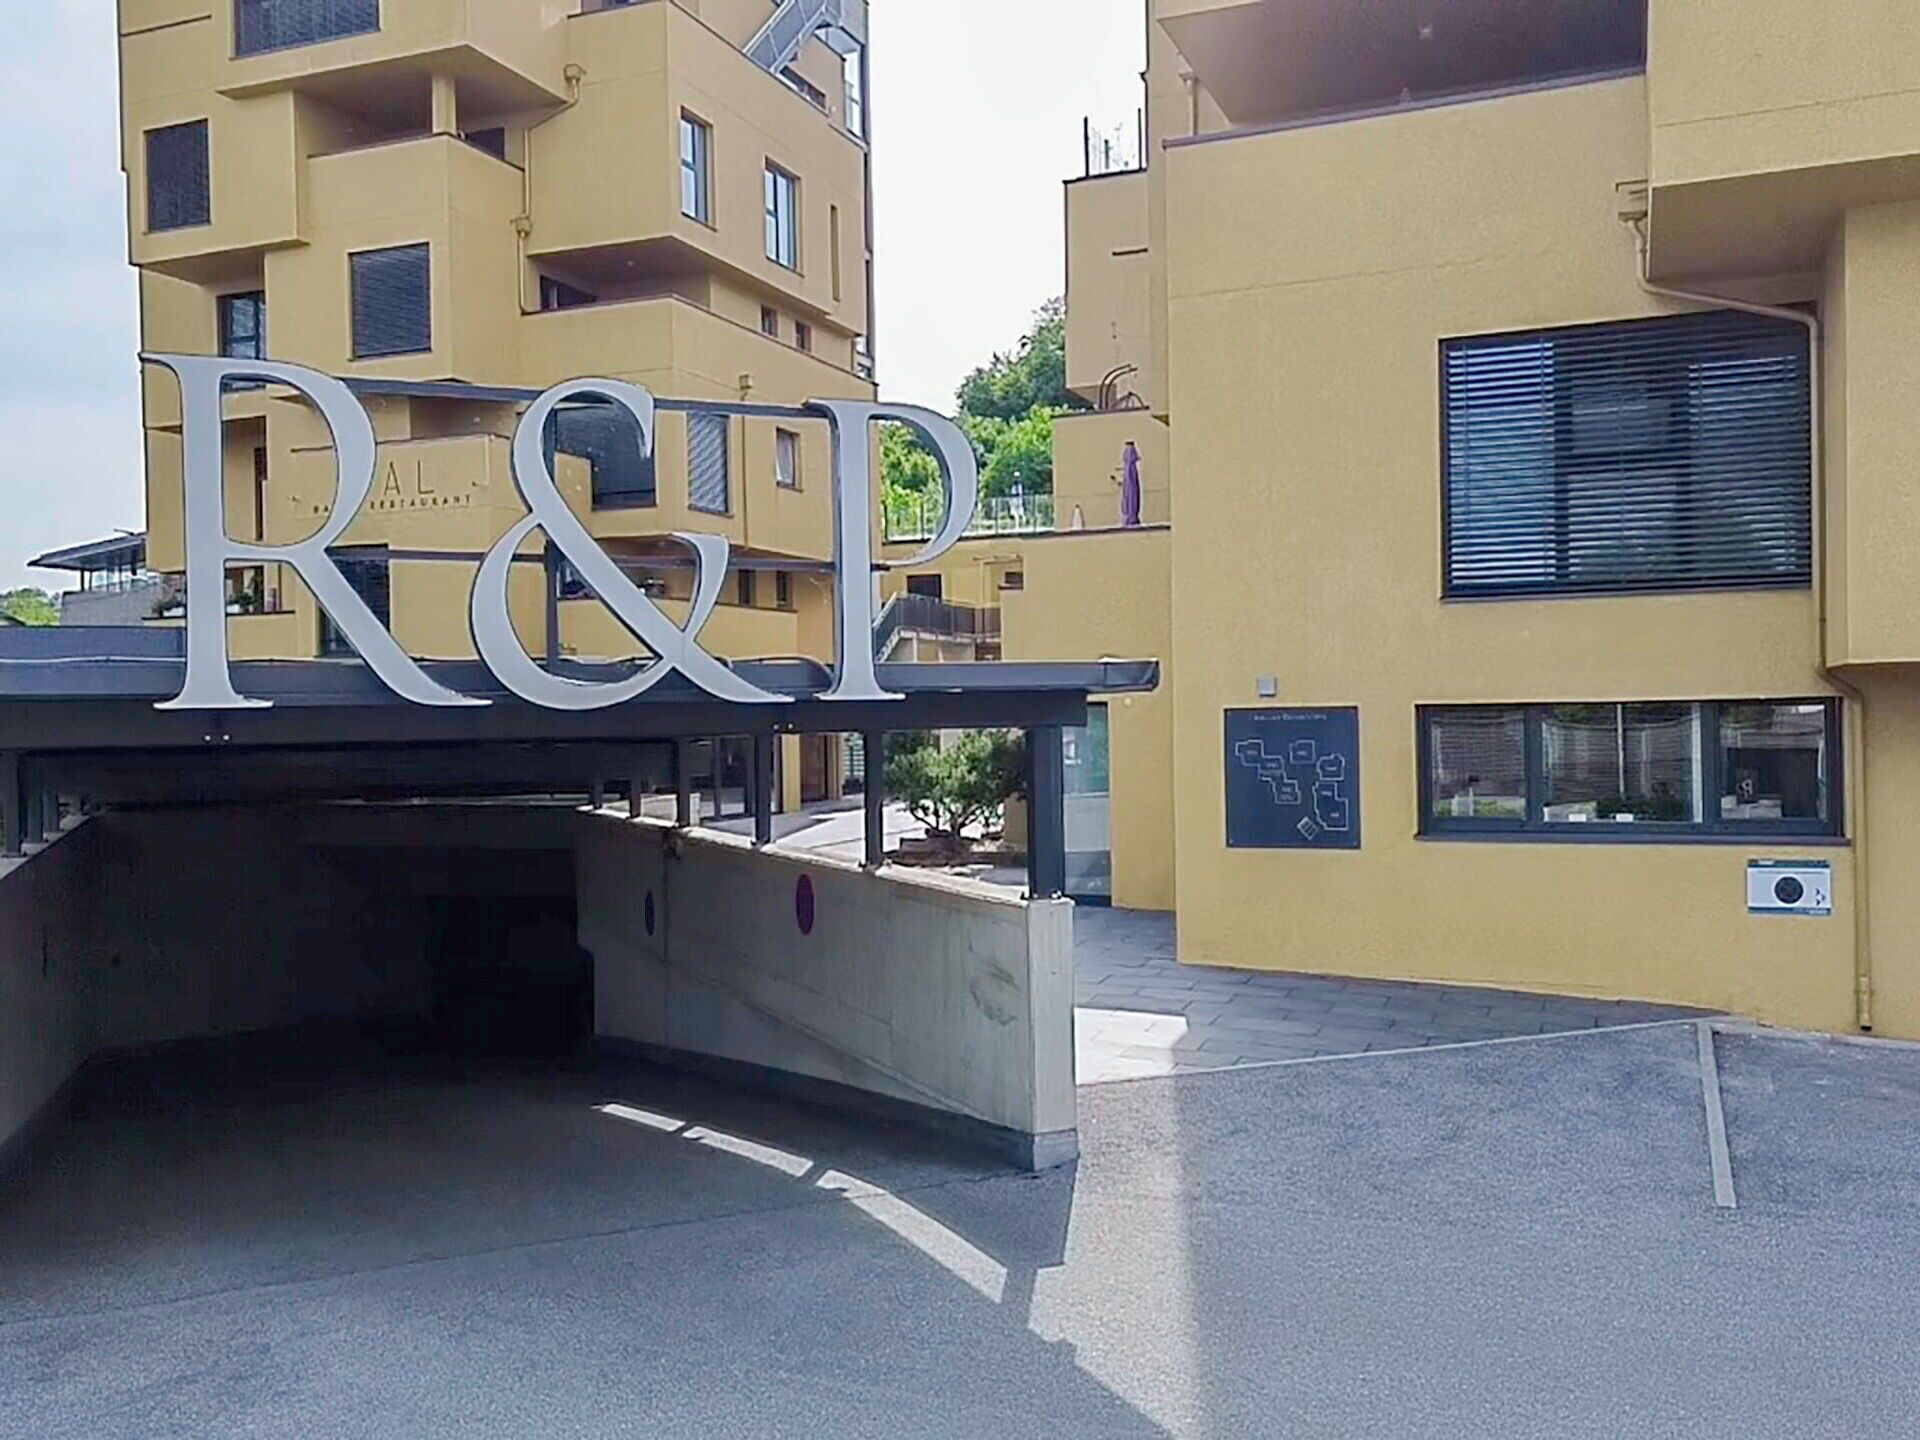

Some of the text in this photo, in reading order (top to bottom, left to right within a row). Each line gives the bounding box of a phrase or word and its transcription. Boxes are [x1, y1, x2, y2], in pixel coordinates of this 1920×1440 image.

[384, 460, 435, 496] AL
[369, 494, 471, 510] RESTAURANT
[139, 352, 978, 711] R&P
